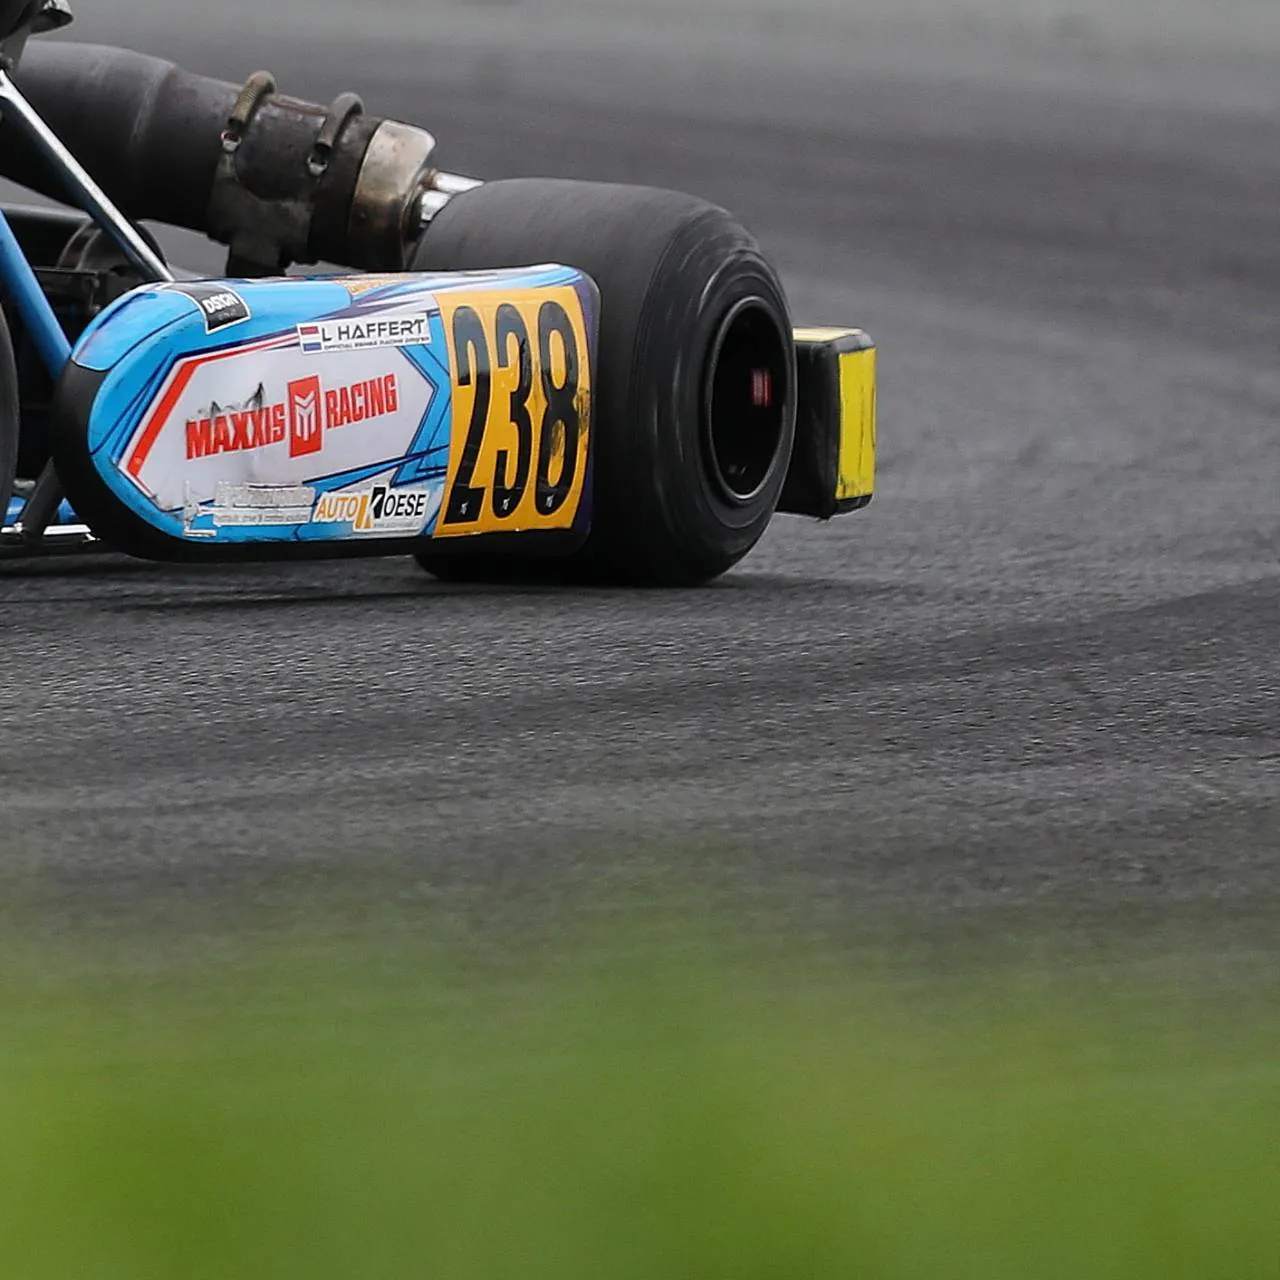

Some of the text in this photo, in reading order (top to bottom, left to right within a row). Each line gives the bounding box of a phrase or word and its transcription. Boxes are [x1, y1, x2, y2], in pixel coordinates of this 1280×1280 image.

[337, 318, 425, 341] HAFFERT
[186, 403, 285, 460] MAXXIS
[325, 373, 398, 430] RACING
[443, 300, 581, 525] 238
[316, 496, 359, 519] AUTO
